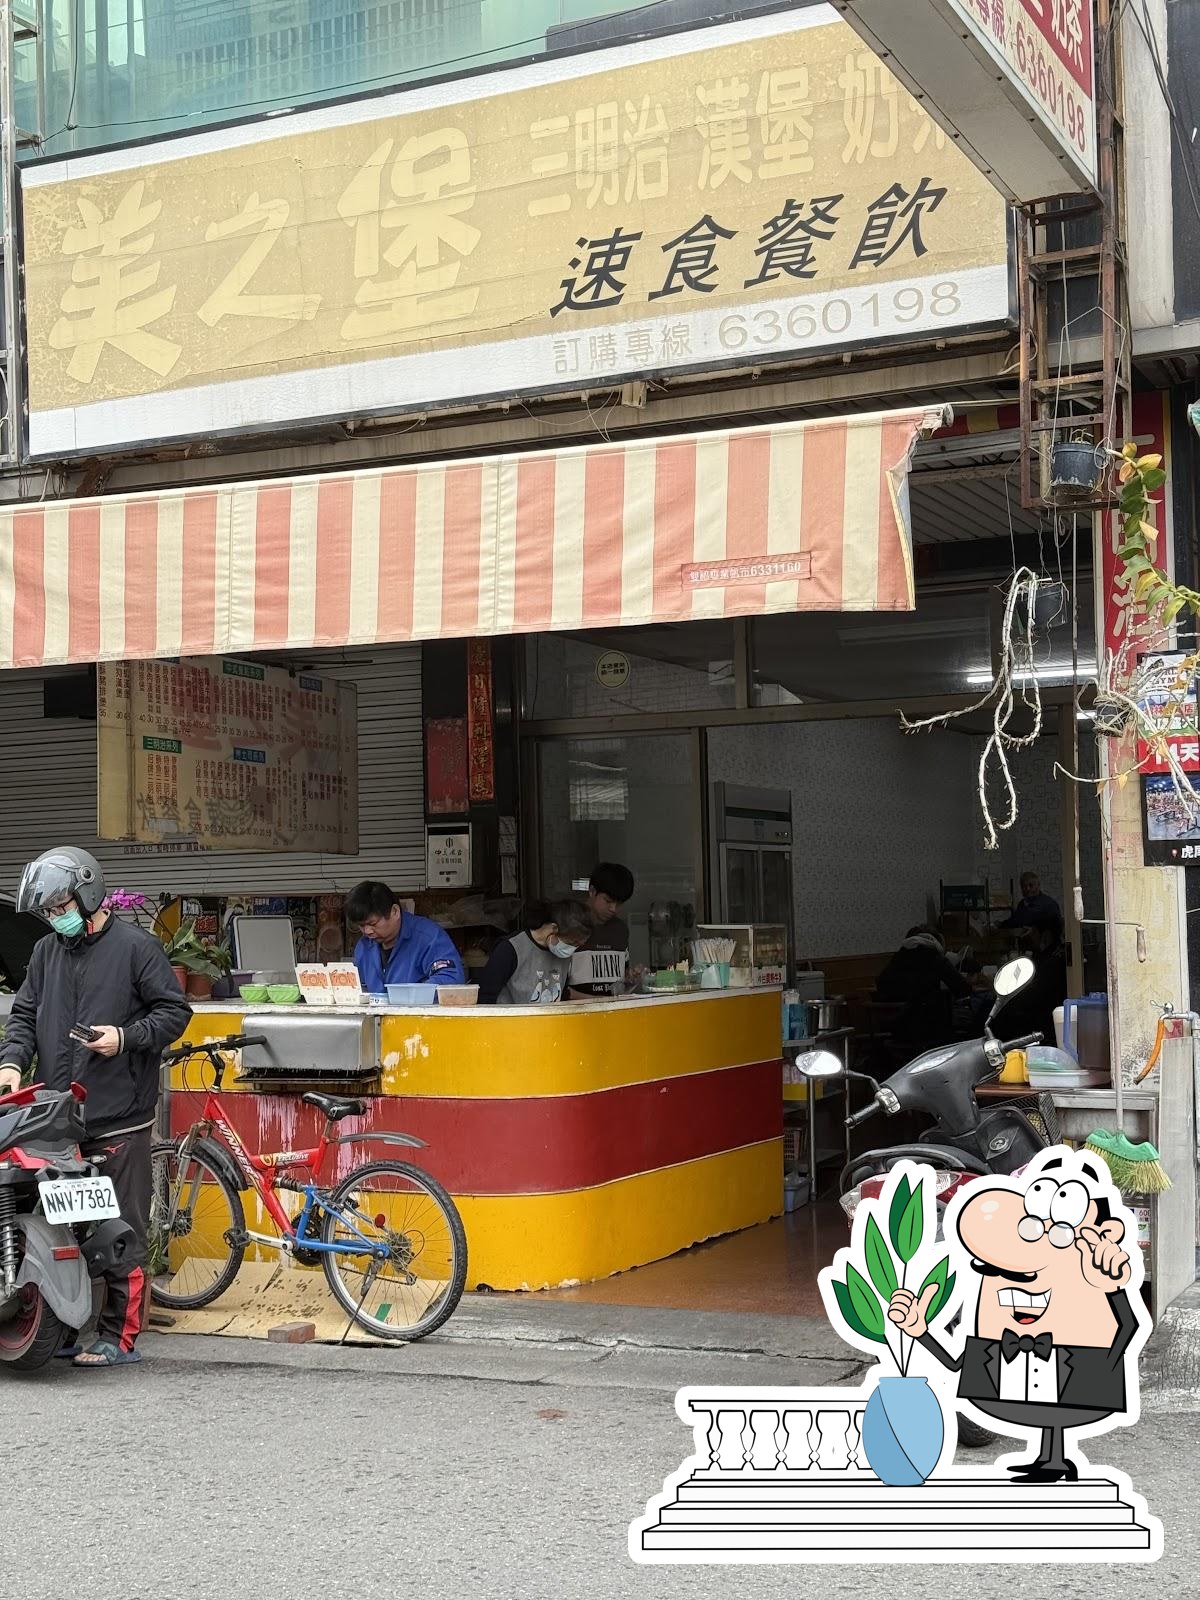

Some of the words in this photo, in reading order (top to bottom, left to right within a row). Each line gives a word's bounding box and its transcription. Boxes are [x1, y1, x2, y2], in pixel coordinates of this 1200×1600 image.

[526, 92, 669, 217] 三明治
[695, 68, 816, 191] 漢堡
[1016, 21, 1085, 152] 6360198
[48, 127, 483, 385] 美之堡
[549, 176, 948, 318] 速食餐飲
[718, 280, 962, 350] 6360198
